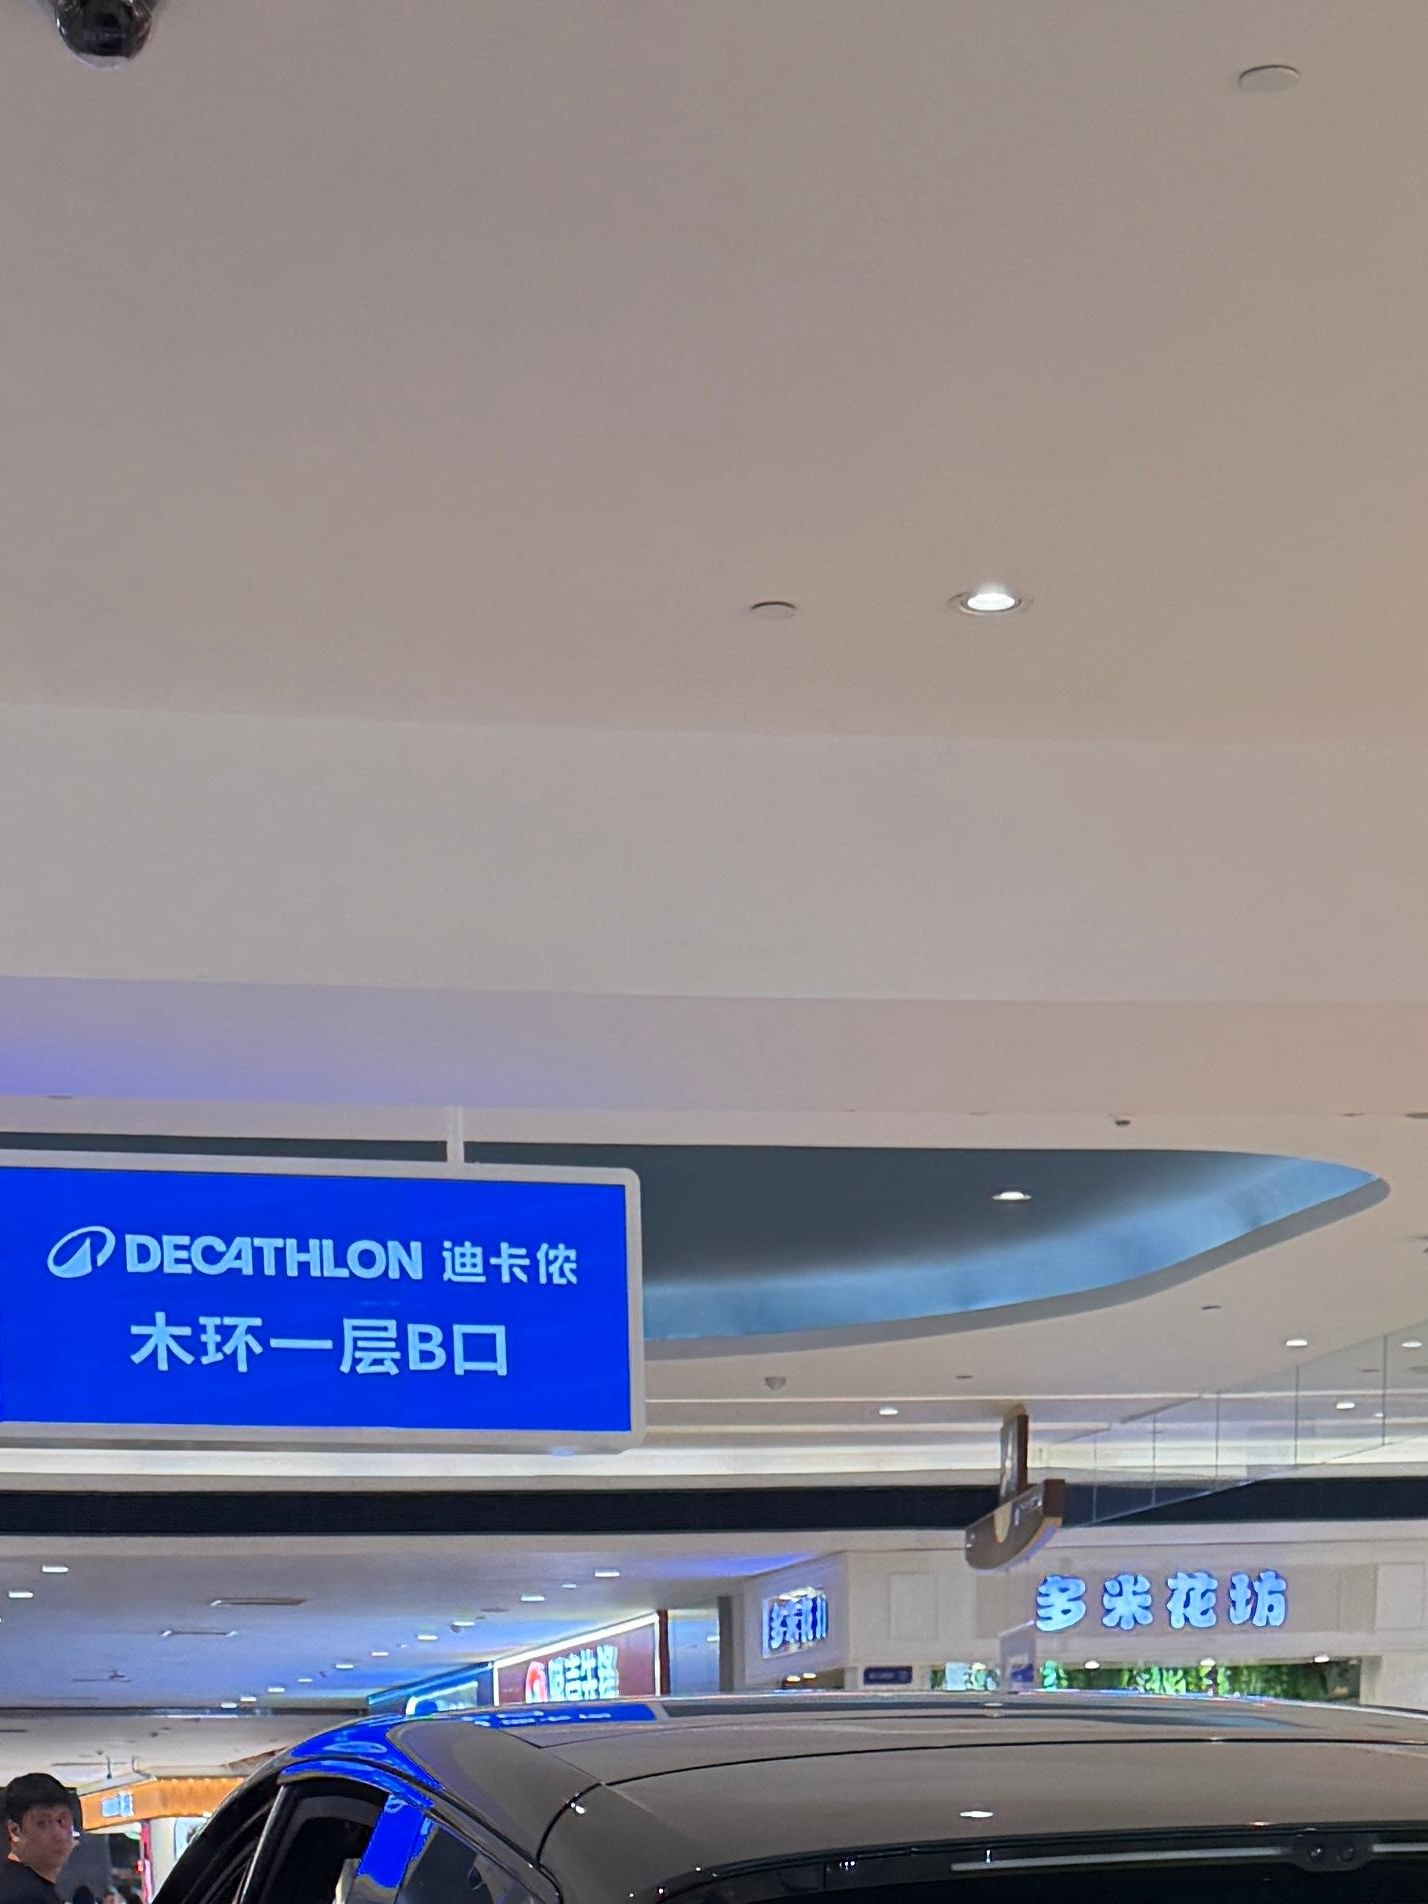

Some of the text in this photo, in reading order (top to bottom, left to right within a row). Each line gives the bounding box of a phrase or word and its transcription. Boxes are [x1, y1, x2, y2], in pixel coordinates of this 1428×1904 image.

[125, 1234, 578, 1286] DECATHLON 迪卡侬
[129, 1311, 510, 1376] 木环一层B口
[1035, 1570, 1289, 1632] 多米花坊
